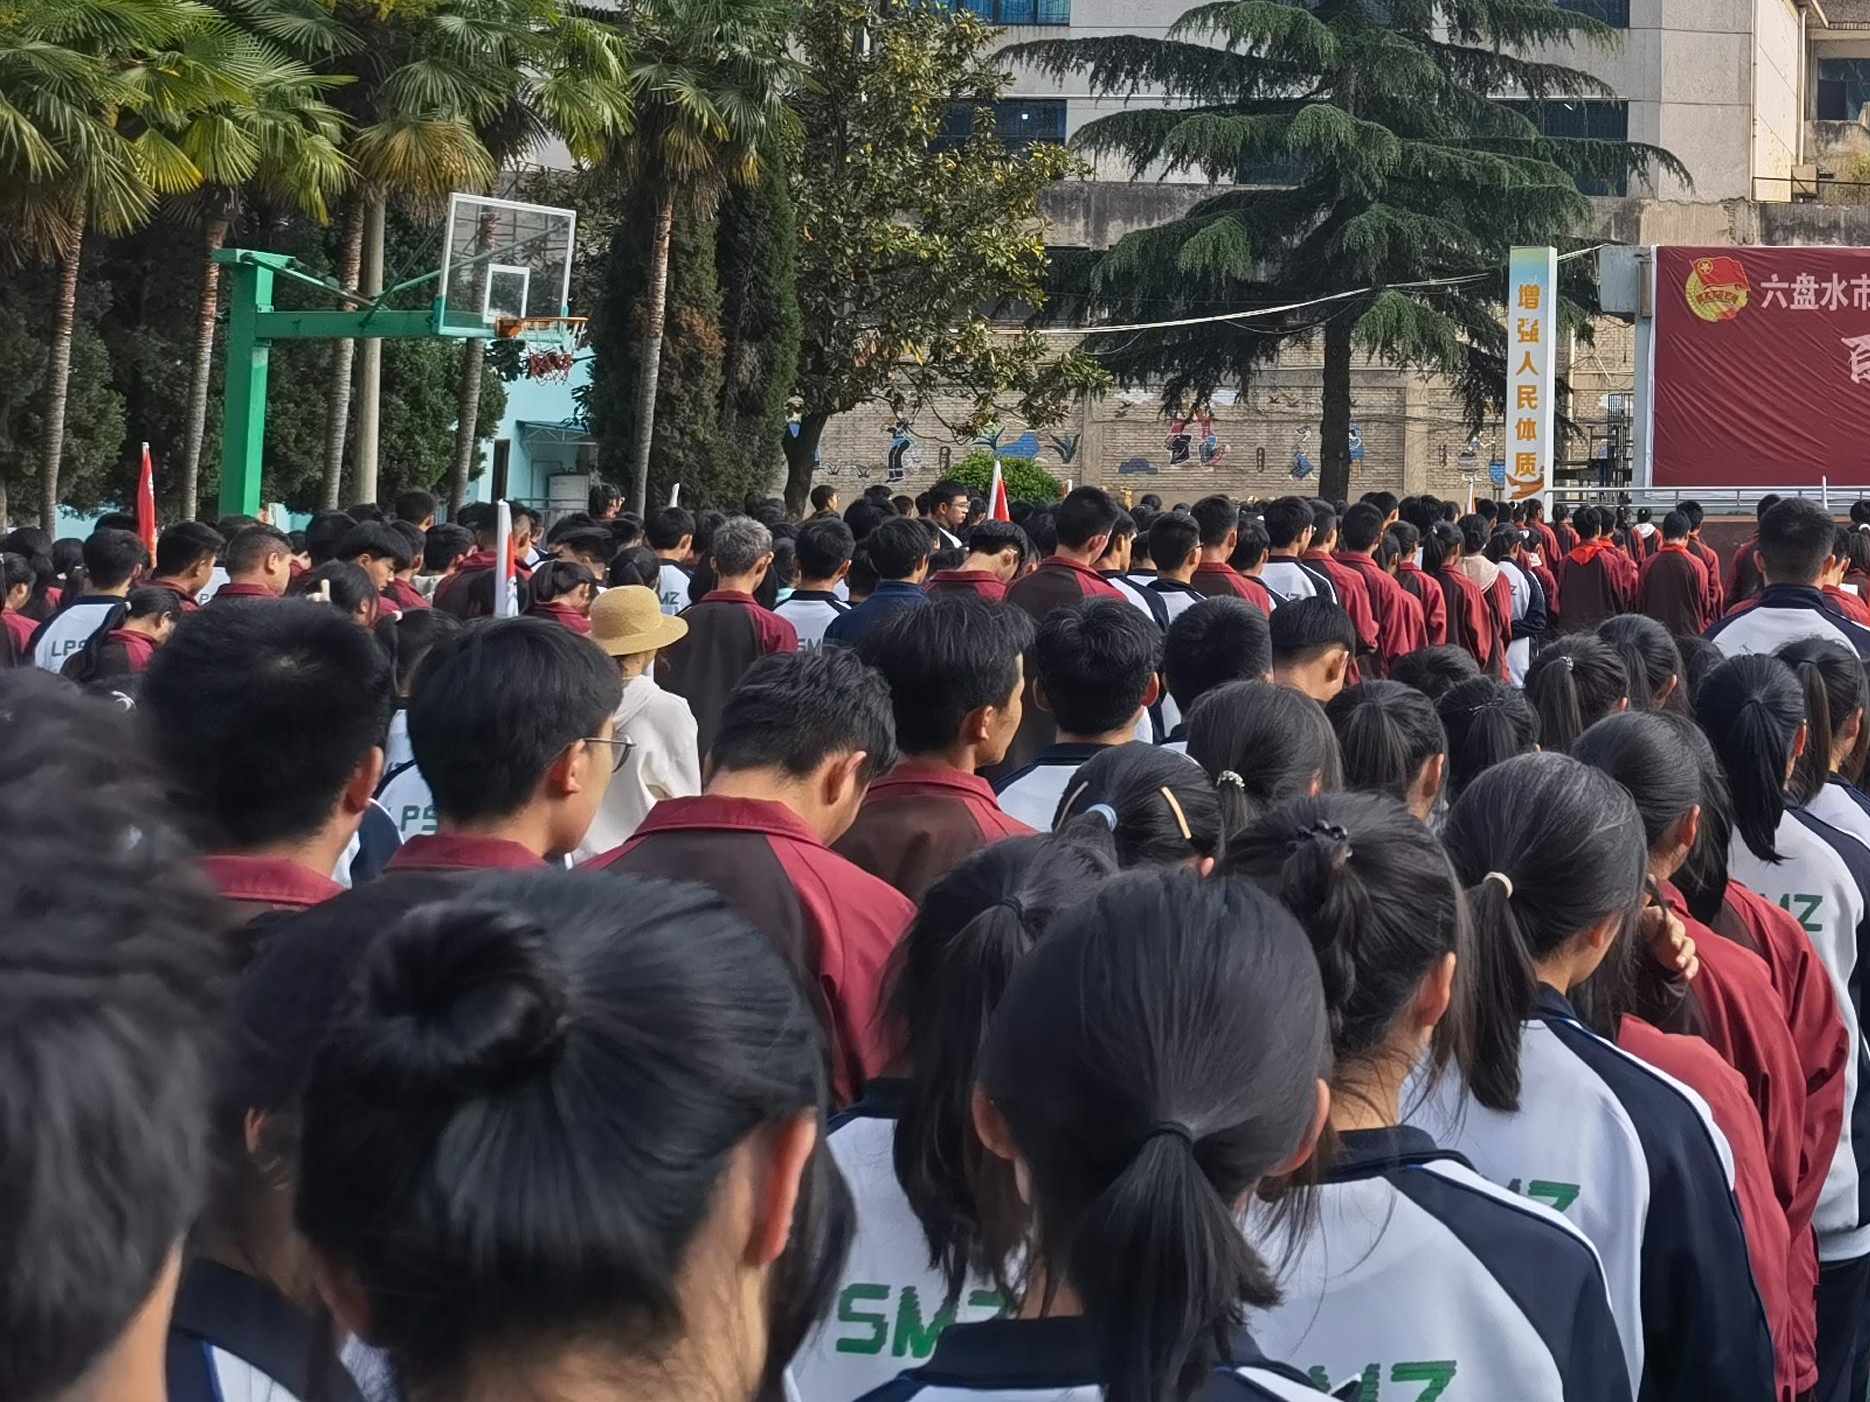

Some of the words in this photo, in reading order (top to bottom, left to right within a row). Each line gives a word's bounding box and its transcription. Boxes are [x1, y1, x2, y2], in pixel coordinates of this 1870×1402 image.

[1515, 284, 1541, 478] 增强人民体质
